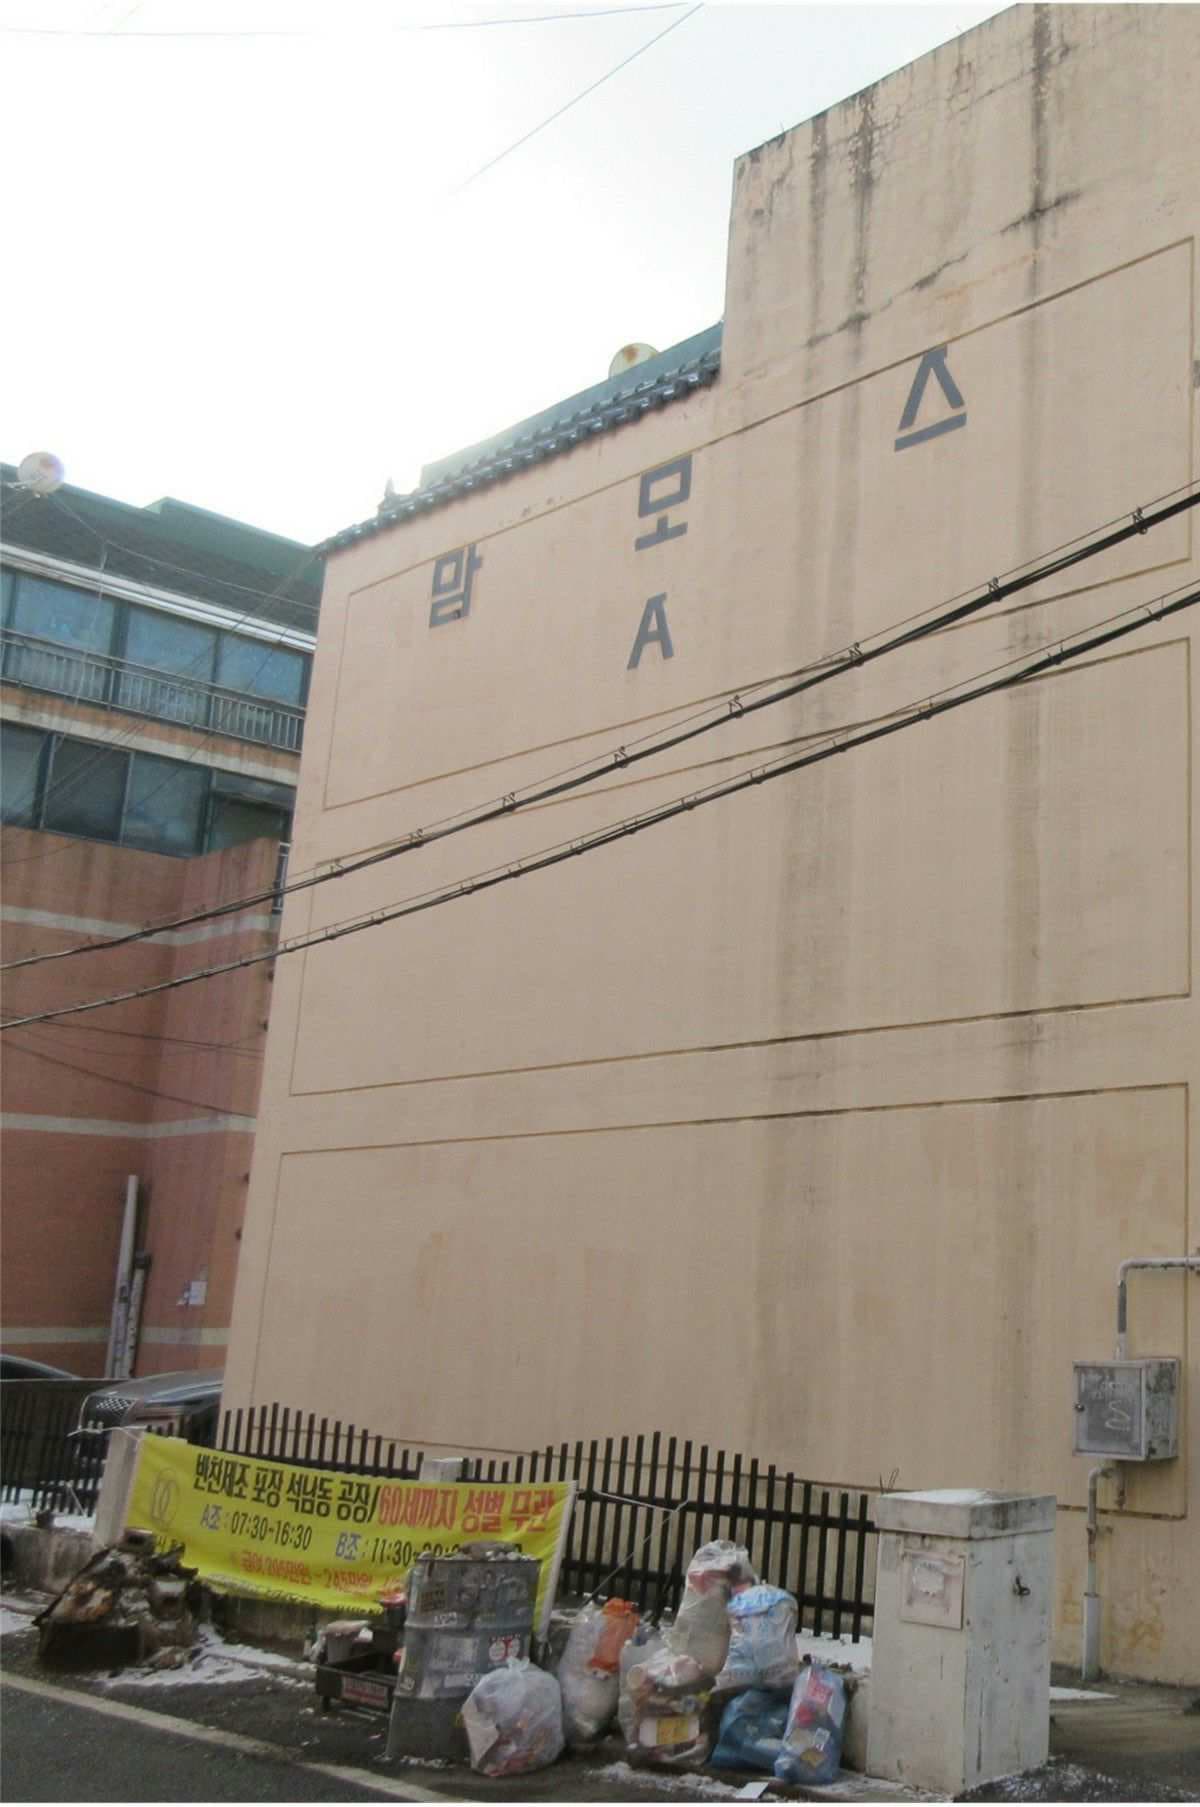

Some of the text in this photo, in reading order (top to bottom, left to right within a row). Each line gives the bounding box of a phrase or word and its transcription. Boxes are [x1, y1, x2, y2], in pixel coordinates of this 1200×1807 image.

[626, 591, 675, 671] A
[251, 1466, 285, 1508] 포장
[286, 1471, 334, 1518] 석남동
[462, 1488, 506, 1534] 성별
